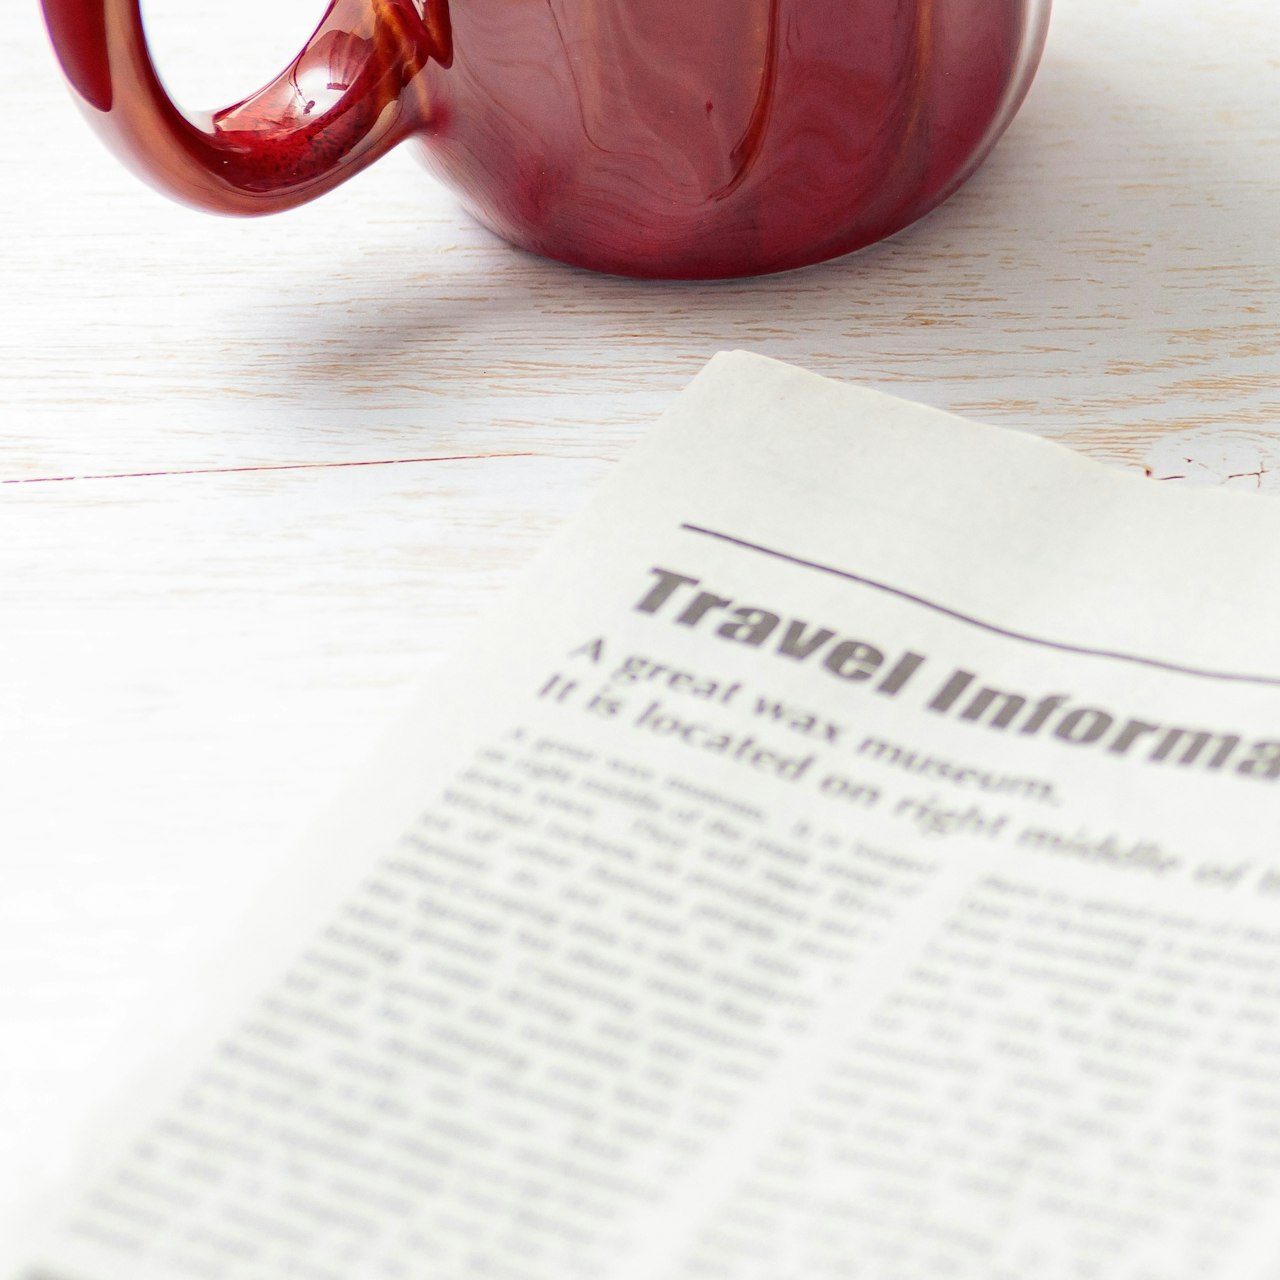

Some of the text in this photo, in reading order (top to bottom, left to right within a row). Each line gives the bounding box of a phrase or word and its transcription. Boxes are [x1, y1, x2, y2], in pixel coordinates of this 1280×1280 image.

[634, 567, 926, 697] Travel
[537, 672, 580, 704] It
[587, 684, 620, 718] is
[633, 698, 813, 783] located
[819, 772, 882, 808] on
[893, 795, 1009, 840] right
[568, 637, 1066, 808] A great wax museum.
